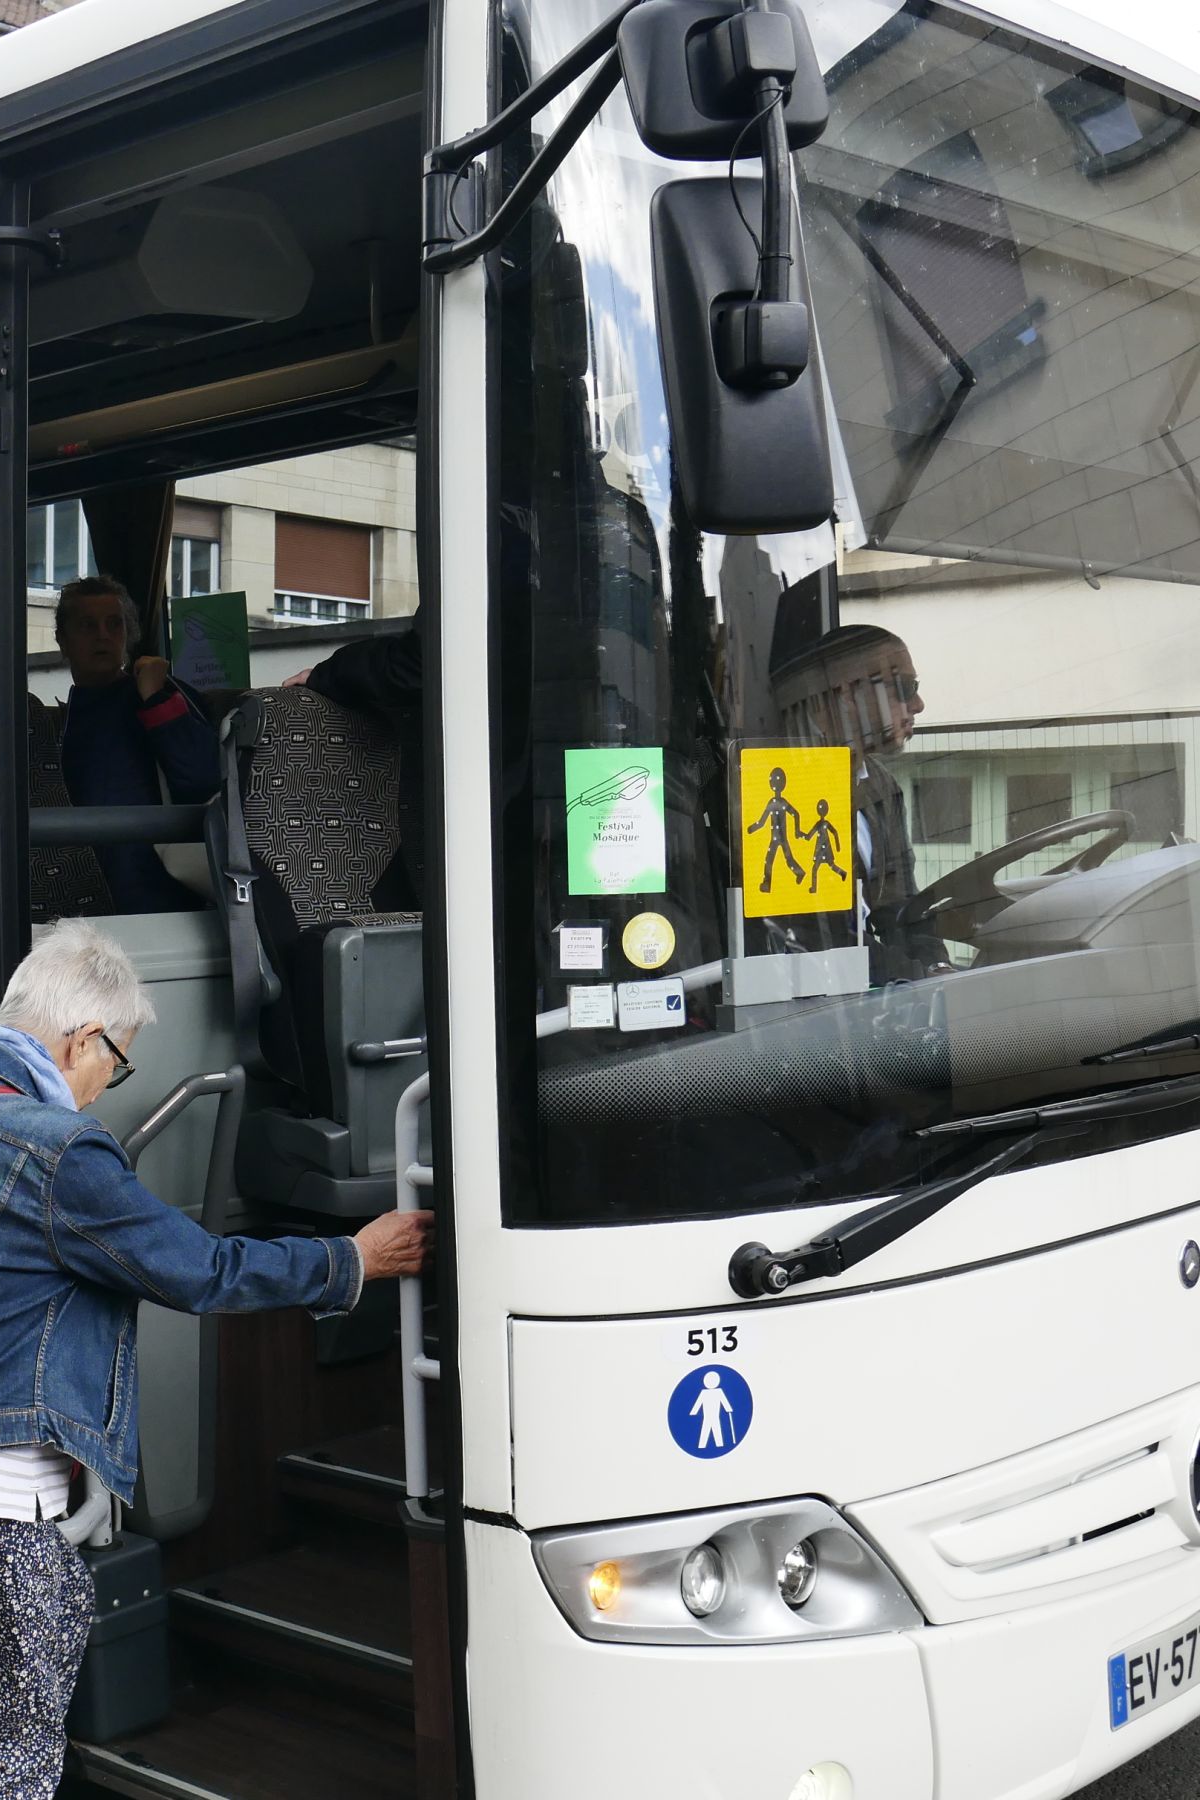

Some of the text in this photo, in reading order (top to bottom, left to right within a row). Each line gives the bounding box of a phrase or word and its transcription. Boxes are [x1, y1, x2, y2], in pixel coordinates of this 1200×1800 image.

[597, 821, 634, 831] Festival
[592, 833, 640, 842] Mosaïque
[687, 1325, 738, 1356] 513
[1129, 1625, 1200, 1710] EV-57
